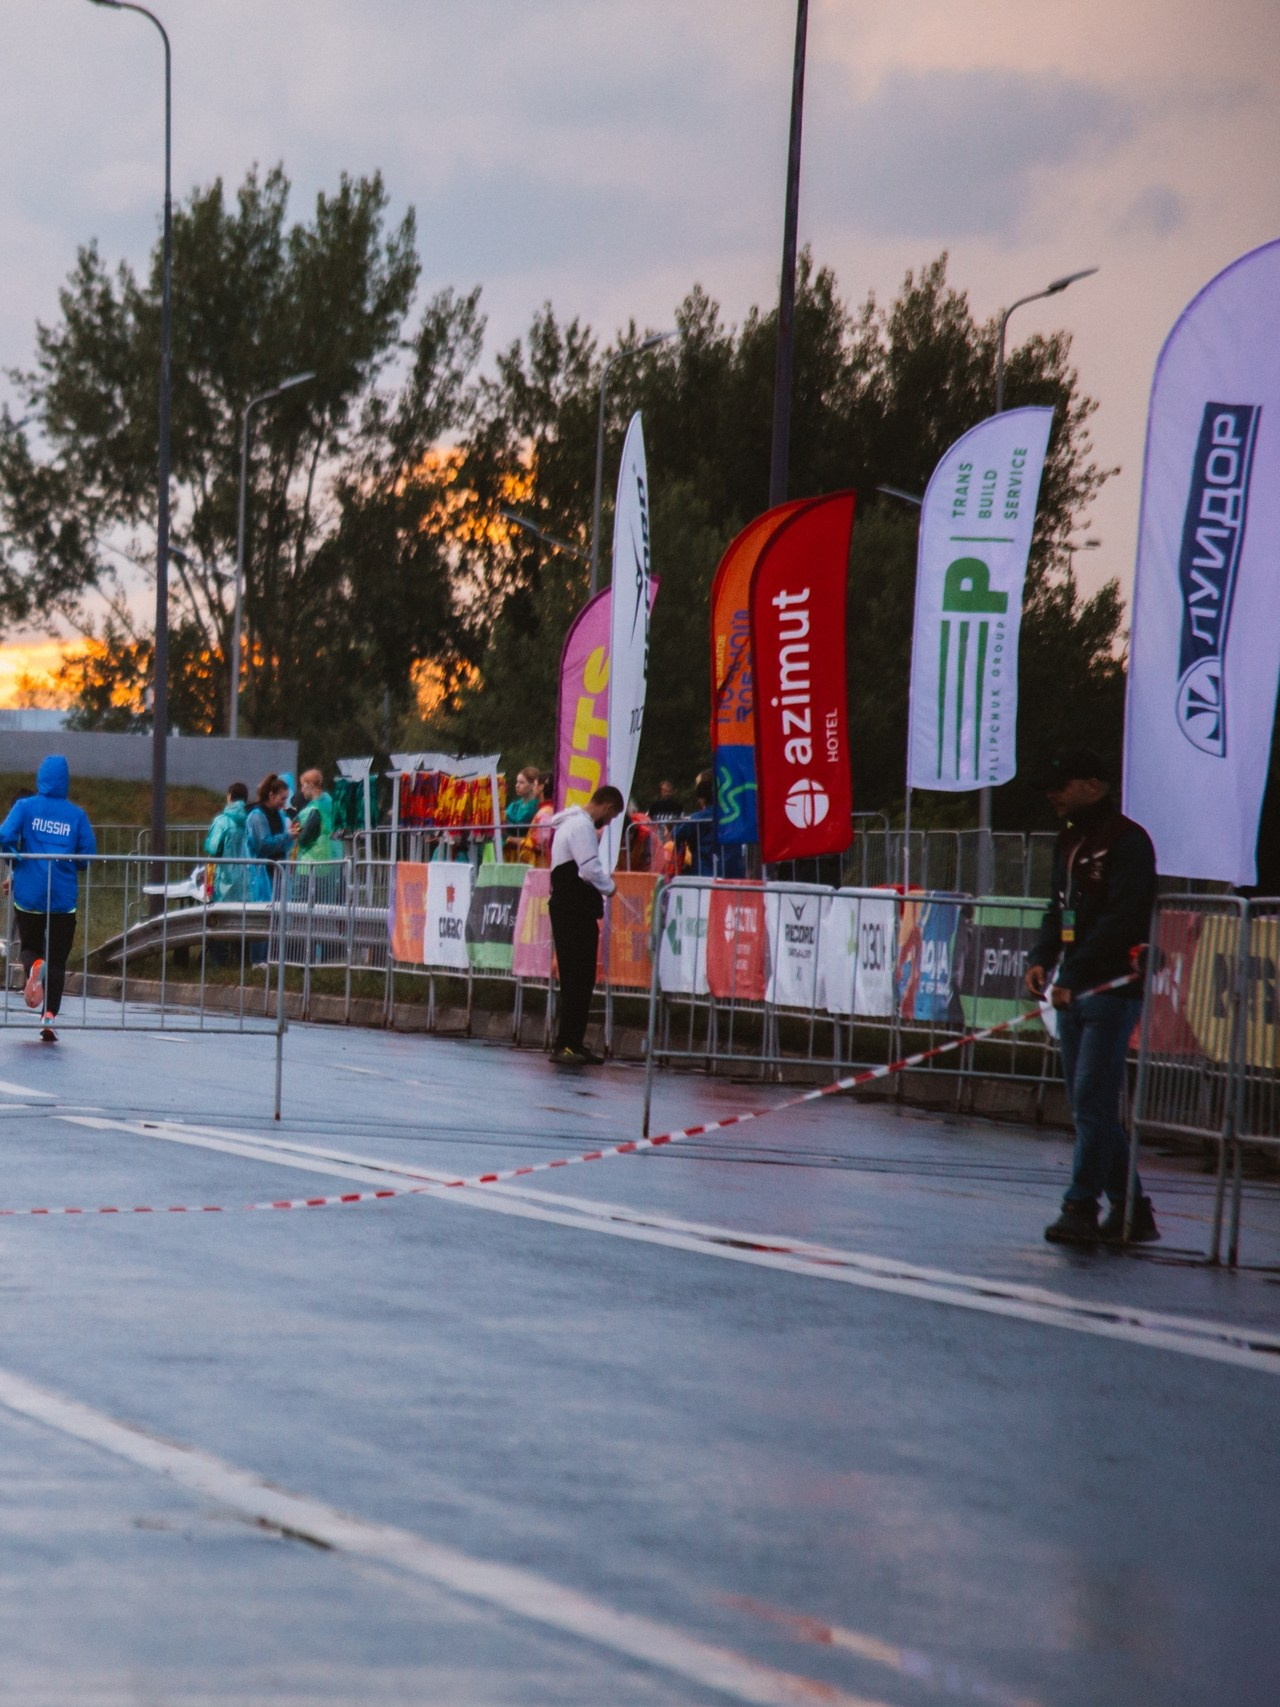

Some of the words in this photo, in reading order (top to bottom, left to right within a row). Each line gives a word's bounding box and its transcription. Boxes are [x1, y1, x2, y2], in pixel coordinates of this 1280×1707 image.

[951, 462, 974, 519] TRANS
[978, 470, 998, 519] BUILD
[1004, 447, 1028, 520] SERVICE
[1189, 413, 1242, 645] ЛУИДОР
[772, 587, 812, 765] azimut
[992, 621, 1006, 678] GROUP
[826, 707, 839, 763] HOTEL
[989, 689, 1001, 782] PILIPCHUK
[32, 817, 71, 837] RUSSIA
